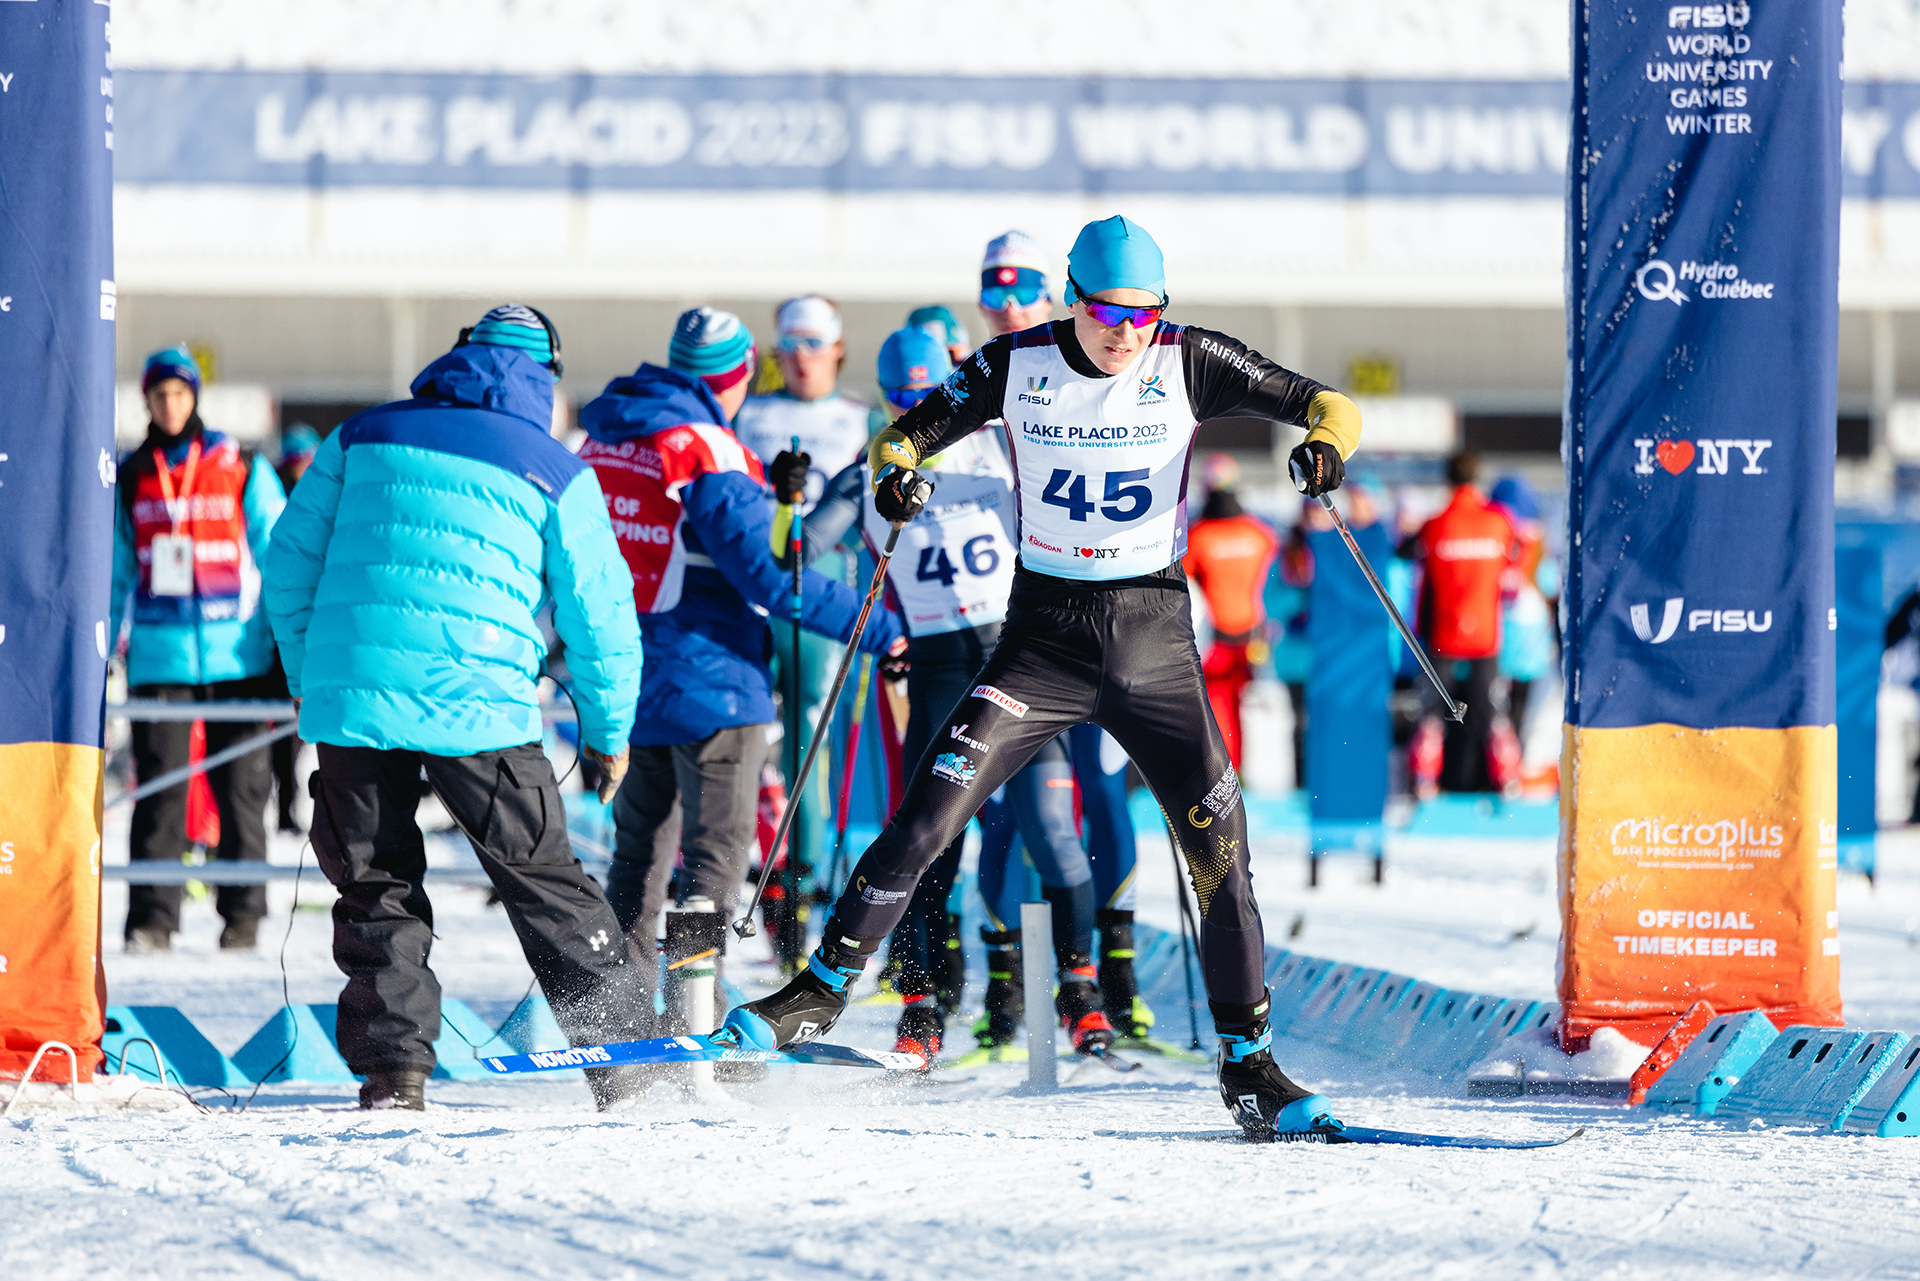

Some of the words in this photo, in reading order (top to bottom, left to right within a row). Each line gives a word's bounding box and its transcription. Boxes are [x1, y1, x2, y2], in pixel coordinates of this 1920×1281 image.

[1668, 5, 1750, 27] FISU
[1667, 35, 1751, 55] WORLD
[1646, 60, 1773, 82] UNIVERSITY
[1670, 87, 1747, 108] GAMES
[256, 95, 439, 164] LAKE
[443, 96, 693, 167] PLACID
[862, 104, 1056, 170] FISU
[1069, 105, 1369, 172] WORLD
[1665, 113, 1751, 134] WINTER
[1679, 261, 1738, 282] Hydro
[1701, 278, 1774, 298] Québec
[1018, 393, 1051, 406] FISU
[1023, 421, 1063, 438] LAKE
[1069, 427, 1128, 440] PLACID
[1132, 424, 1167, 438] 2023
[1024, 435, 1041, 444] FISU
[1043, 439, 1075, 447] WORLD
[1137, 437, 1168, 446] GAMES
[1634, 439, 1654, 474] I
[1696, 439, 1772, 475] NY
[1041, 467, 1152, 522] 45
[614, 495, 641, 517] OF
[1033, 540, 1062, 553] QIAODAN
[1094, 548, 1120, 558] NY
[917, 534, 1000, 587] 46
[1688, 609, 1773, 632] FISU
[974, 687, 1025, 714] RAIFFEISEN
[1202, 780, 1225, 806] CENTRE
[1206, 800, 1218, 810] DE
[1212, 802, 1223, 814] SKI
[1612, 845, 1642, 857] DATA
[1646, 846, 1720, 858] PROCESSING
[1739, 848, 1781, 858] TIMING
[1638, 910, 1754, 930] OFFICIAL
[1613, 935, 1777, 956] TIMEKEEPER
[528, 1046, 612, 1069] SALOMON
[717, 1050, 768, 1061] SALOMON
